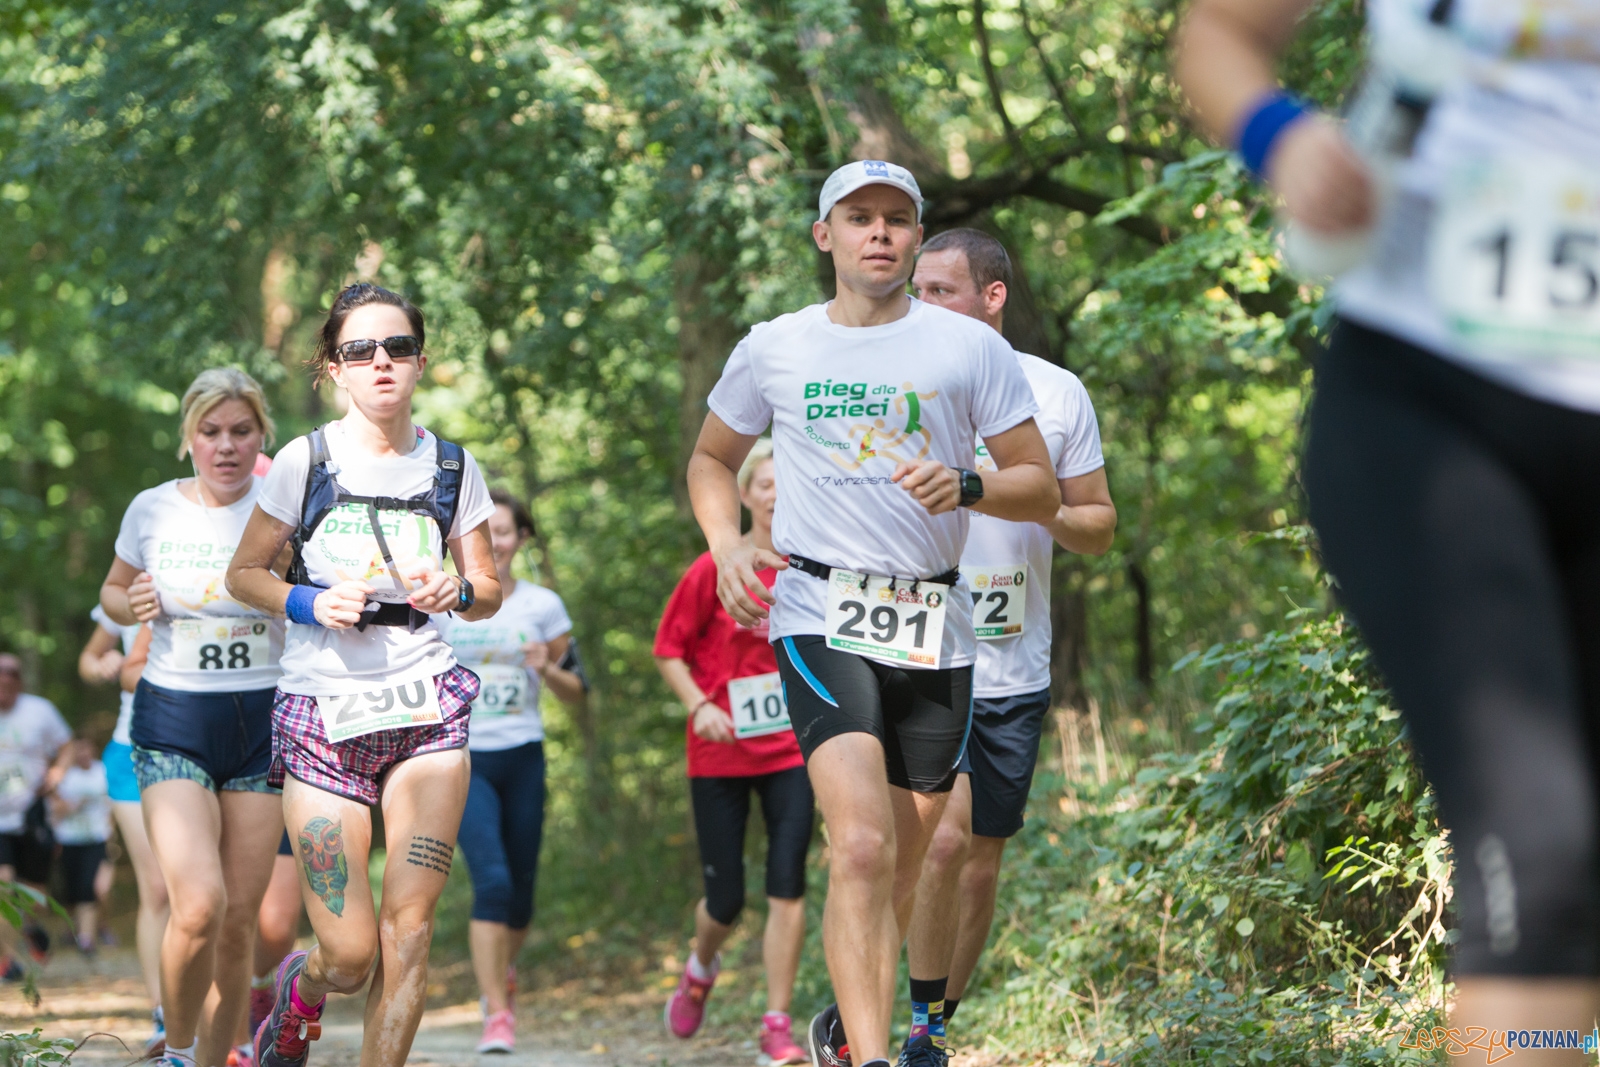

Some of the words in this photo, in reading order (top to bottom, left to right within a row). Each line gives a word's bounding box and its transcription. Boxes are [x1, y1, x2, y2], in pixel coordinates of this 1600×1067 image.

[803, 379, 868, 400] Bieg
[872, 384, 897, 395] dla
[806, 398, 890, 421] Dzieci
[812, 475, 831, 488] 17
[323, 514, 402, 537] Dzieci
[159, 539, 213, 557] Bieg
[836, 600, 928, 649] 291
[199, 641, 251, 671] 88
[329, 680, 426, 725] 290
[742, 694, 781, 721] 10
